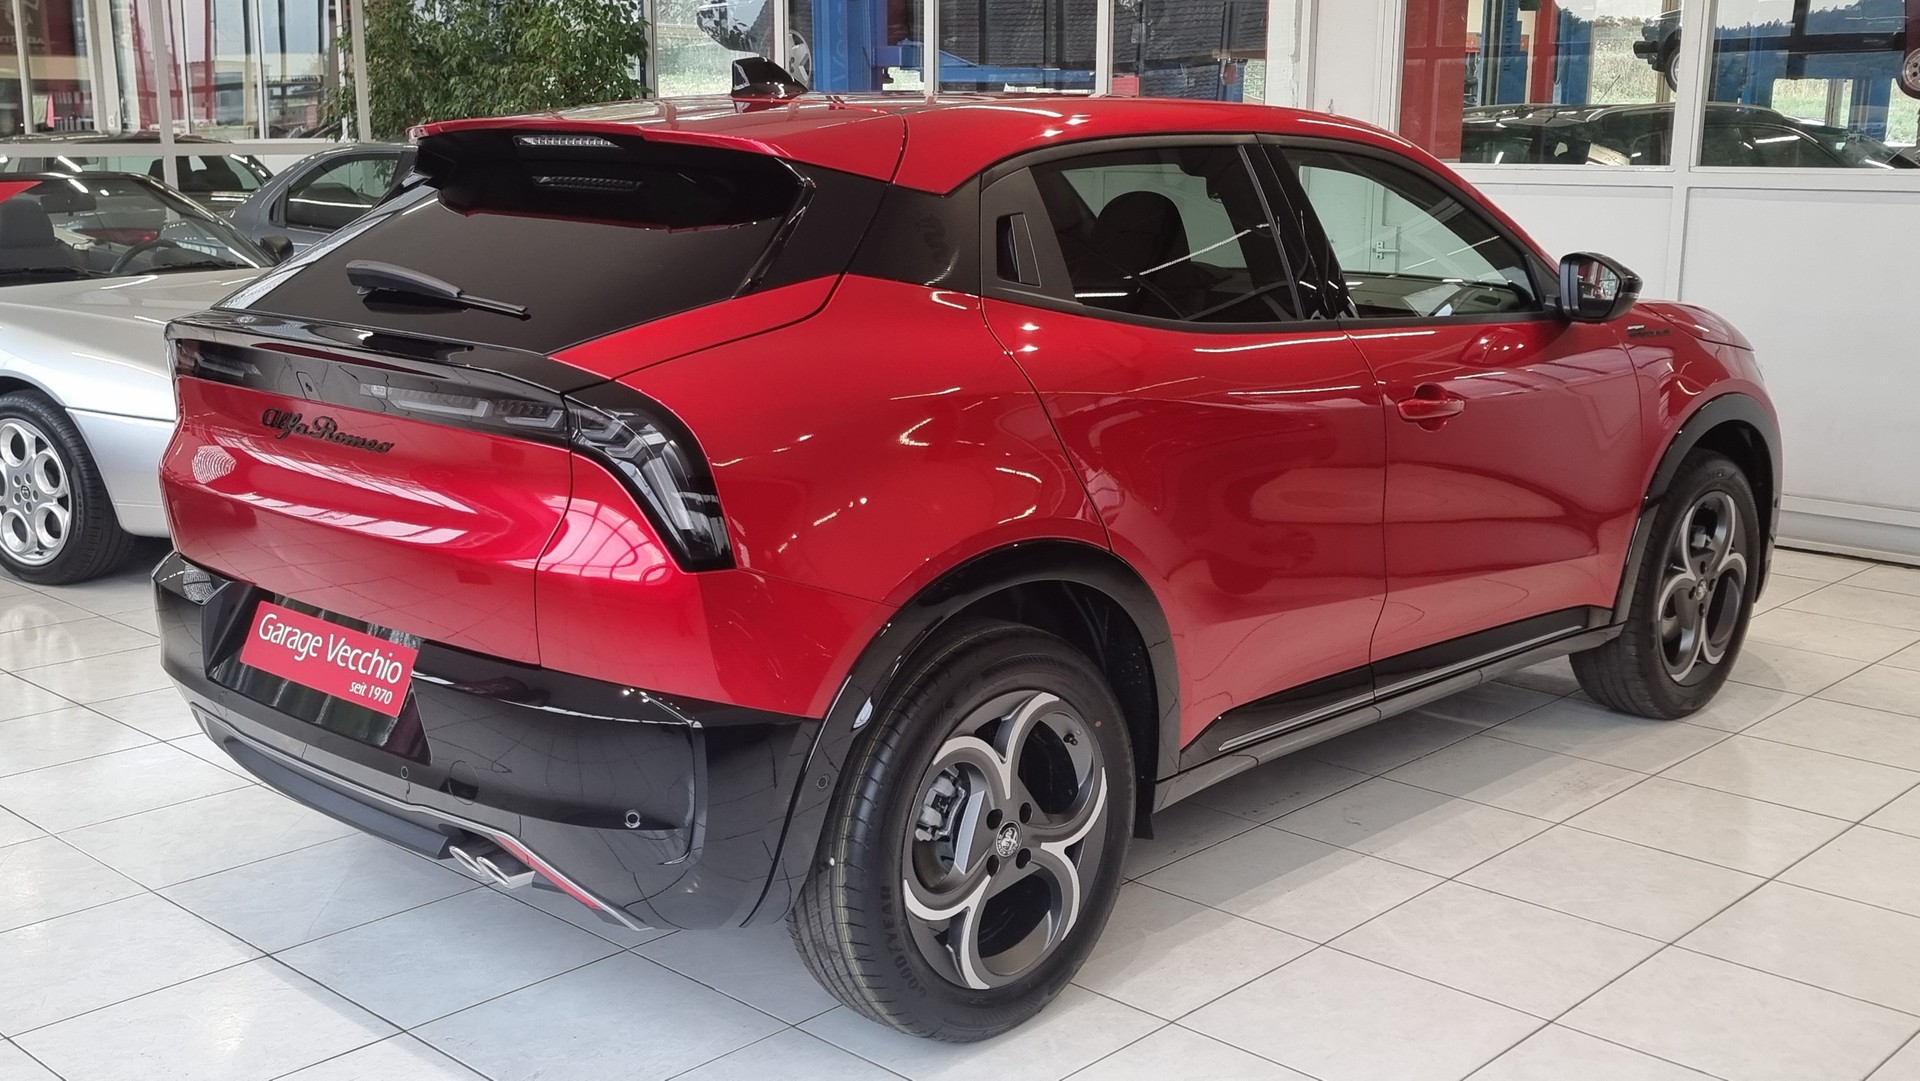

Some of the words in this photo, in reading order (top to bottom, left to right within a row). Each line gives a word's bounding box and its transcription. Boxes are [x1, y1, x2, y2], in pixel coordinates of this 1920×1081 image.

[262, 408, 310, 439] Alfa
[309, 415, 395, 453] Romeo
[258, 613, 323, 662] Garage
[326, 633, 403, 684] Vecchio
[349, 681, 368, 697] seit
[368, 685, 394, 705] 1970
